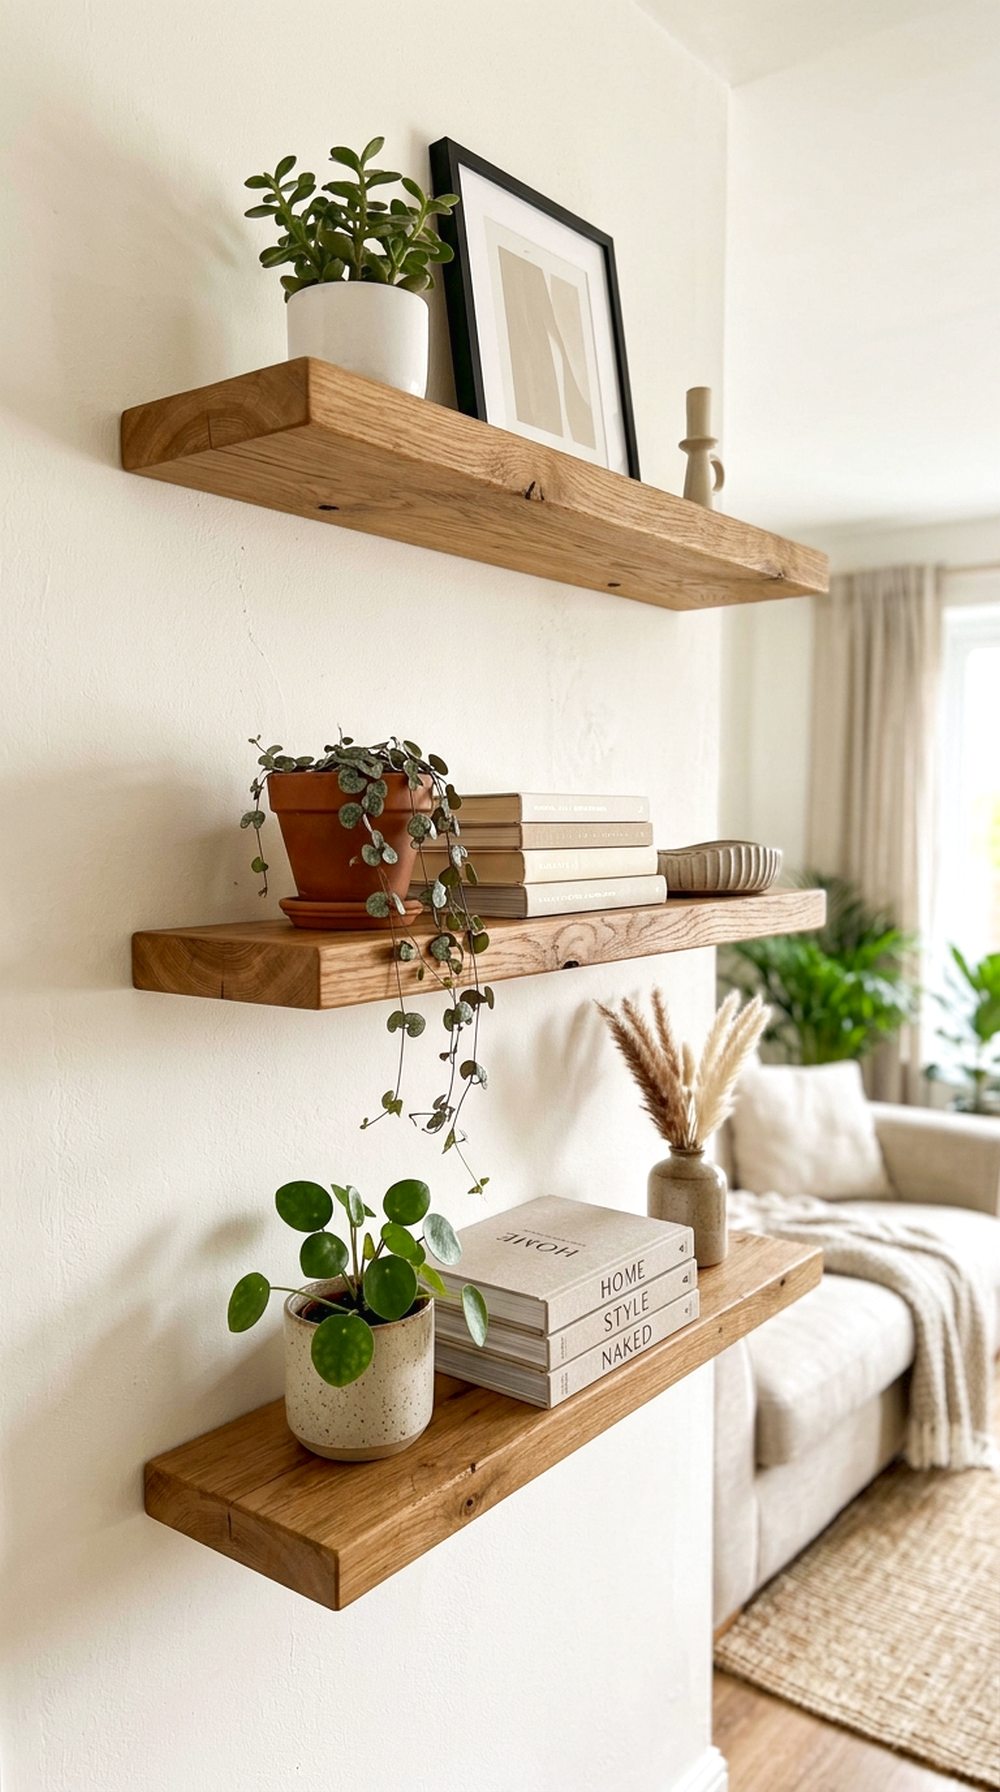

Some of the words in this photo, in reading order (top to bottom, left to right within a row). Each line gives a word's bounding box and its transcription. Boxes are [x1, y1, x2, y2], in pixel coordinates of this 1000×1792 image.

[496, 1232, 580, 1258] HOME
[600, 1259, 646, 1299] HOME
[604, 1290, 650, 1332] STYLE
[601, 1324, 653, 1370] NAKED
